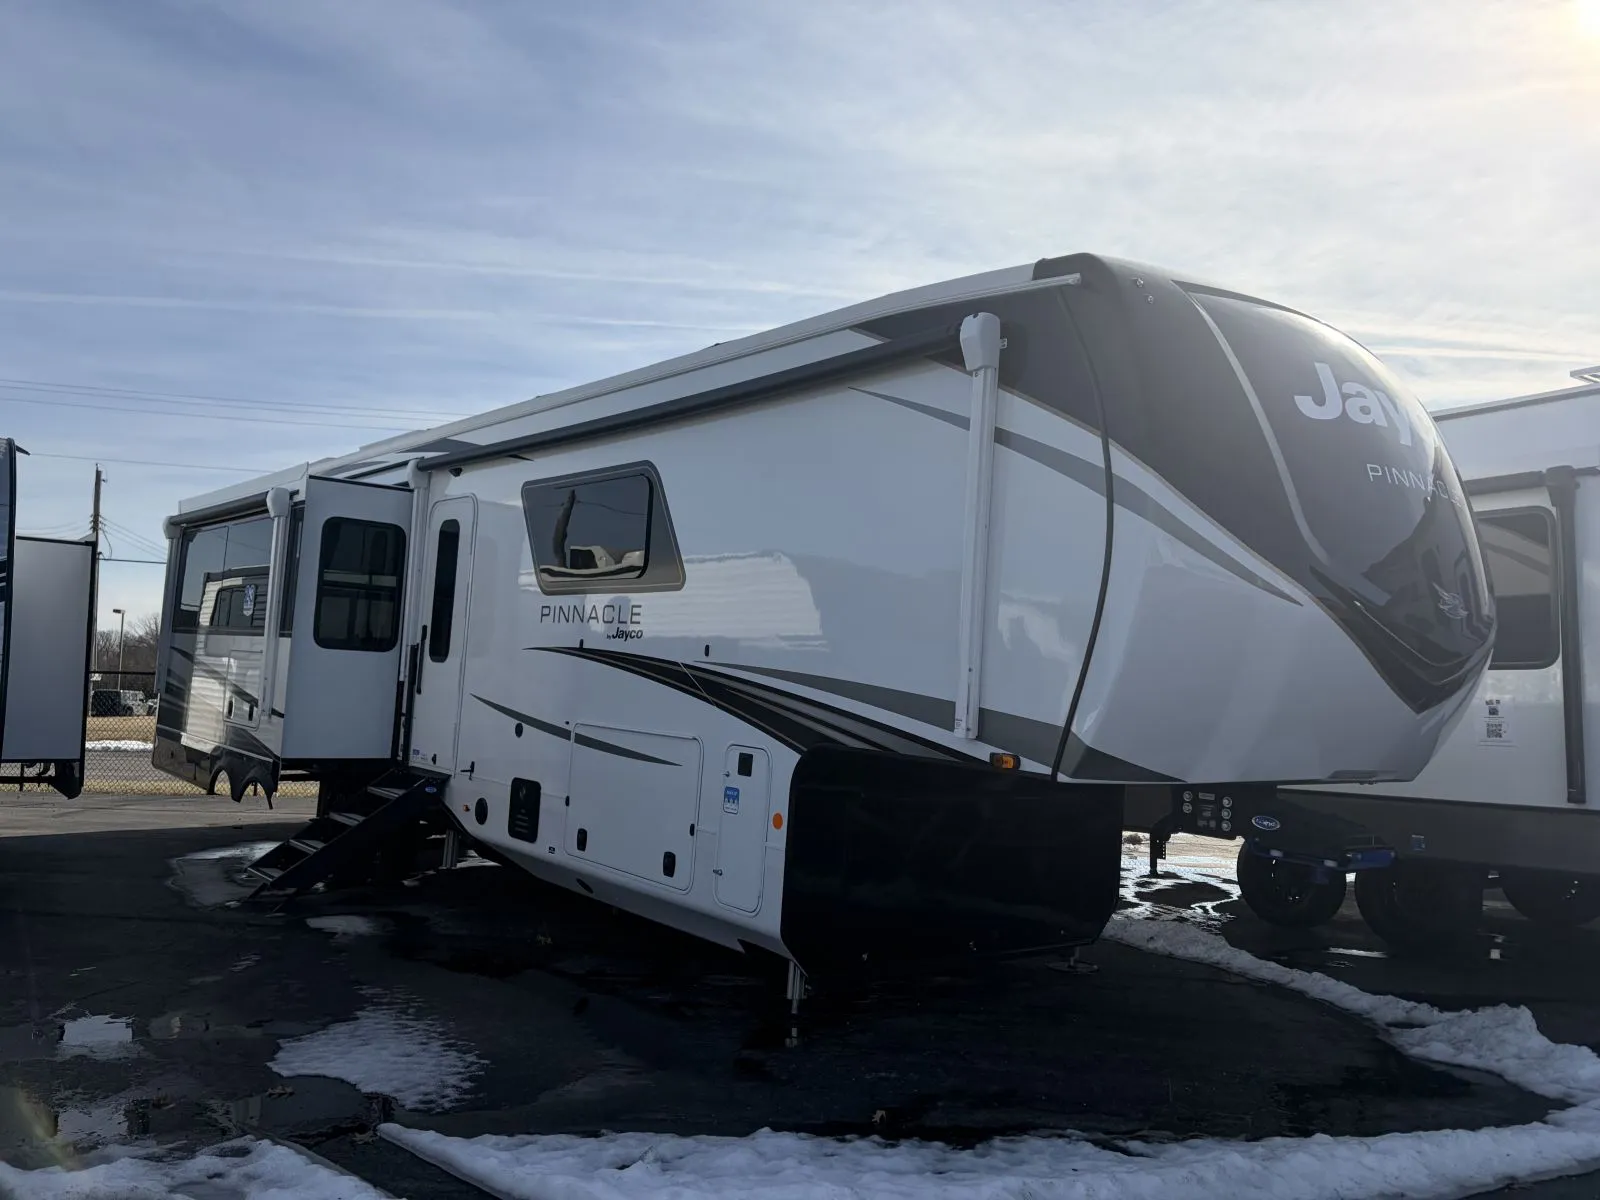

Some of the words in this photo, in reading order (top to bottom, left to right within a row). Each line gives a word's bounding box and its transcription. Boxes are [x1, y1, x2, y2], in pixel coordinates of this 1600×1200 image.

[1294, 362, 1415, 447] Jay
[1366, 463, 1462, 508] PINNAC
[540, 604, 642, 624] PINNACLE
[612, 626, 643, 642] Jayco
